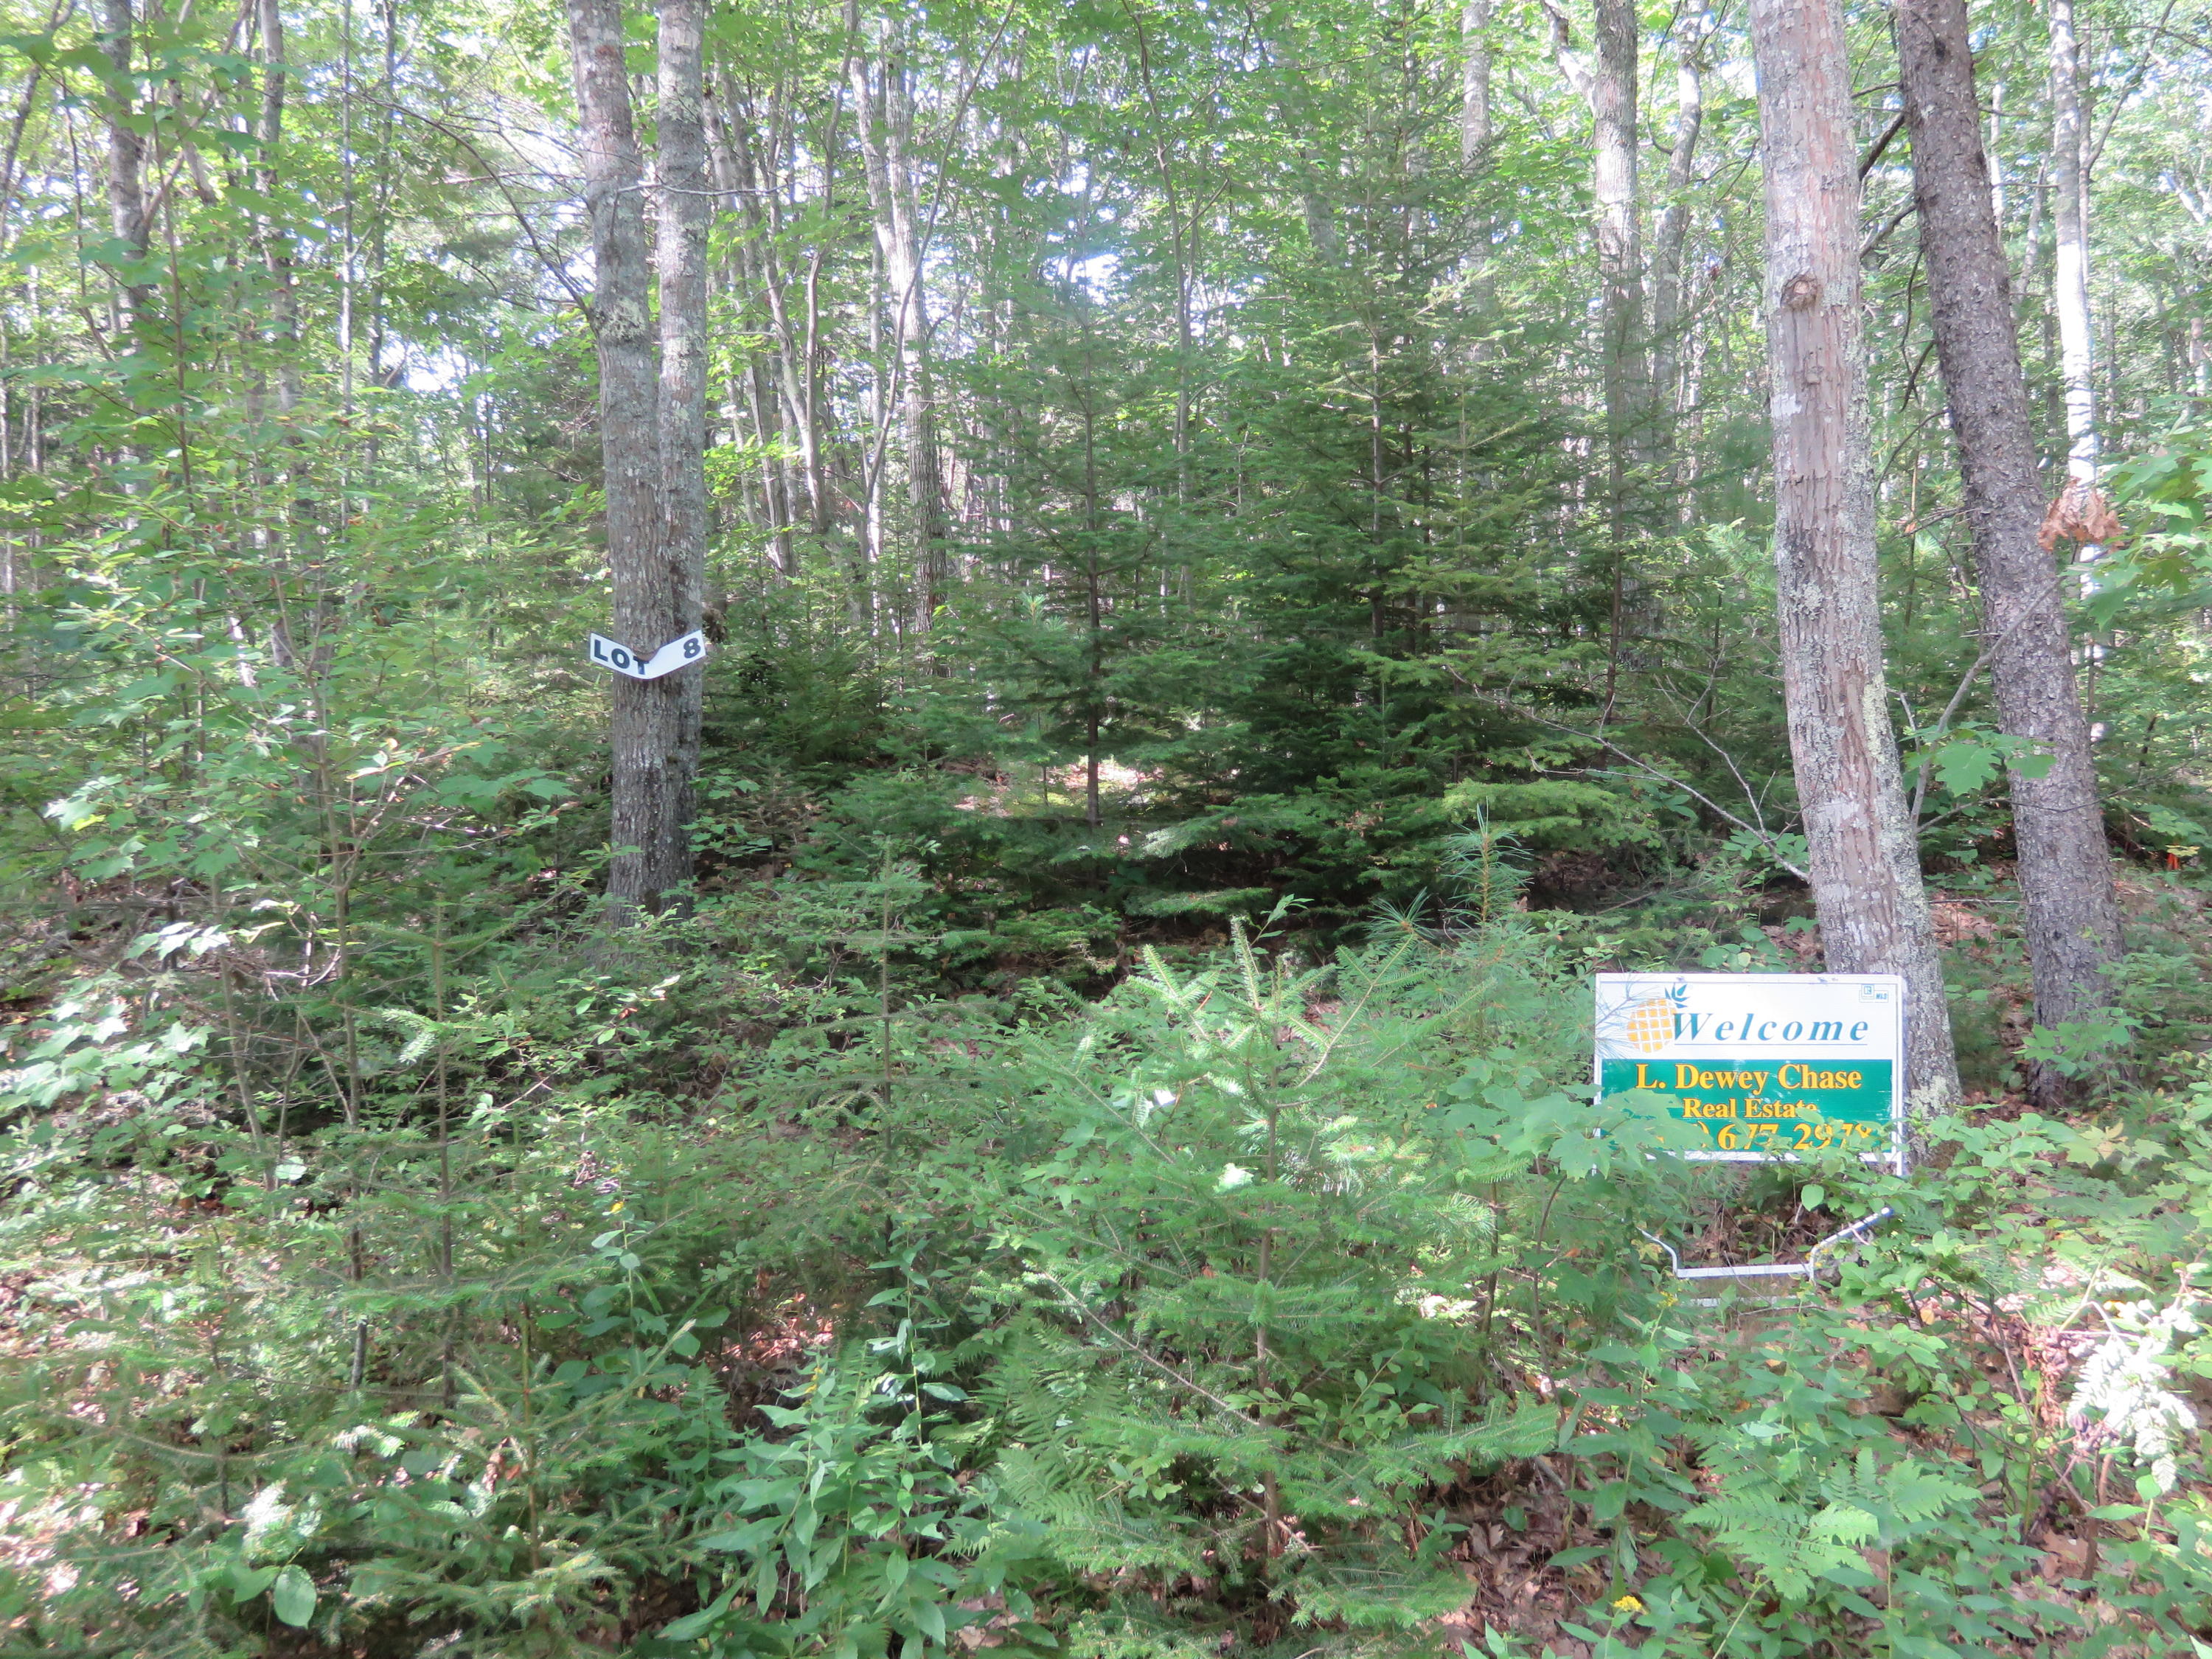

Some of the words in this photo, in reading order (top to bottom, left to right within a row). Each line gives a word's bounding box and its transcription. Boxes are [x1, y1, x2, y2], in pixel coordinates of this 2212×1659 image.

[594, 639, 650, 675] LOT
[683, 637, 701, 659] 8
[1674, 1013, 1868, 1041] Welcome
[1635, 1062, 1667, 1089] L.
[1674, 1064, 1769, 1095] Dewey
[1778, 1063, 1863, 1089] Chase
[1682, 1098, 1736, 1118] Real
